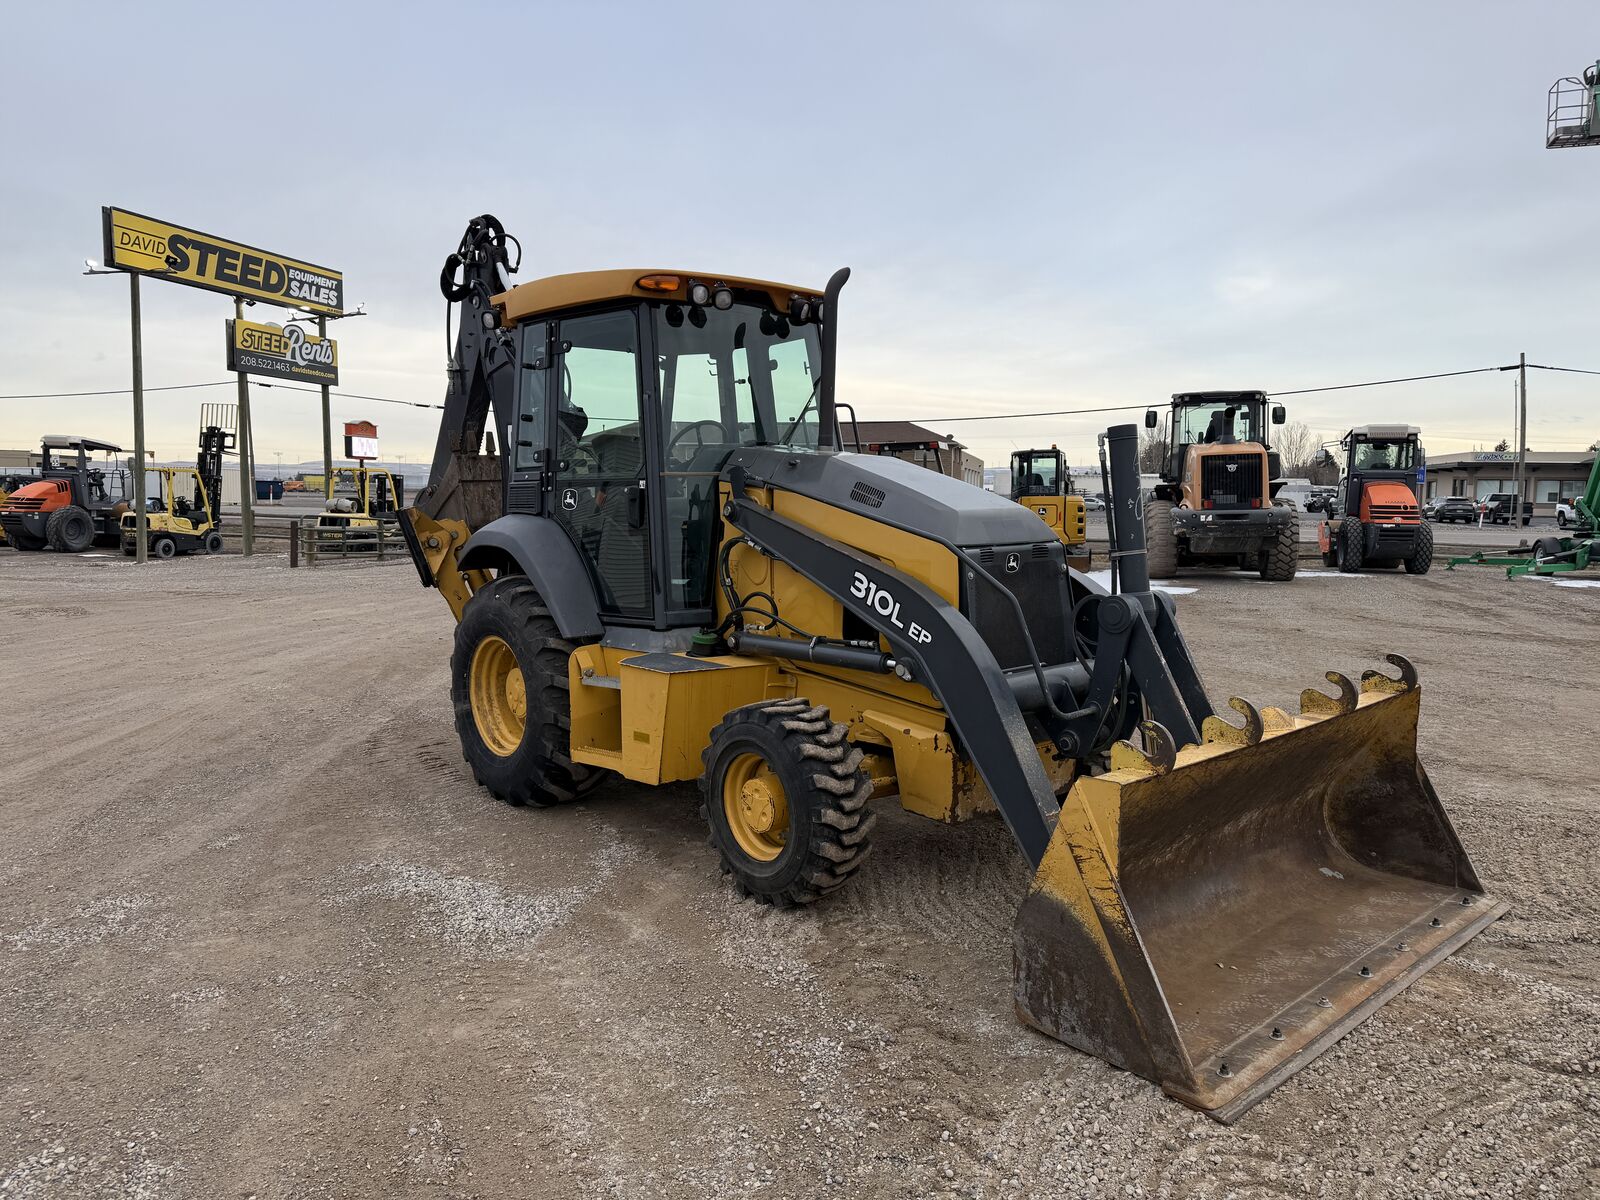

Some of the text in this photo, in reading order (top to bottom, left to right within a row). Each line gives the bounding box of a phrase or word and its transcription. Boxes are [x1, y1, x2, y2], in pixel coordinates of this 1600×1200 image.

[121, 232, 285, 293] DAVID STEED
[289, 269, 337, 289] EQUIPMENT
[290, 281, 338, 306] SALES
[241, 324, 333, 365] STEED Rents
[241, 356, 336, 379] 208.522.1463 davidsteedco.com
[850, 571, 932, 644] 310L EP
